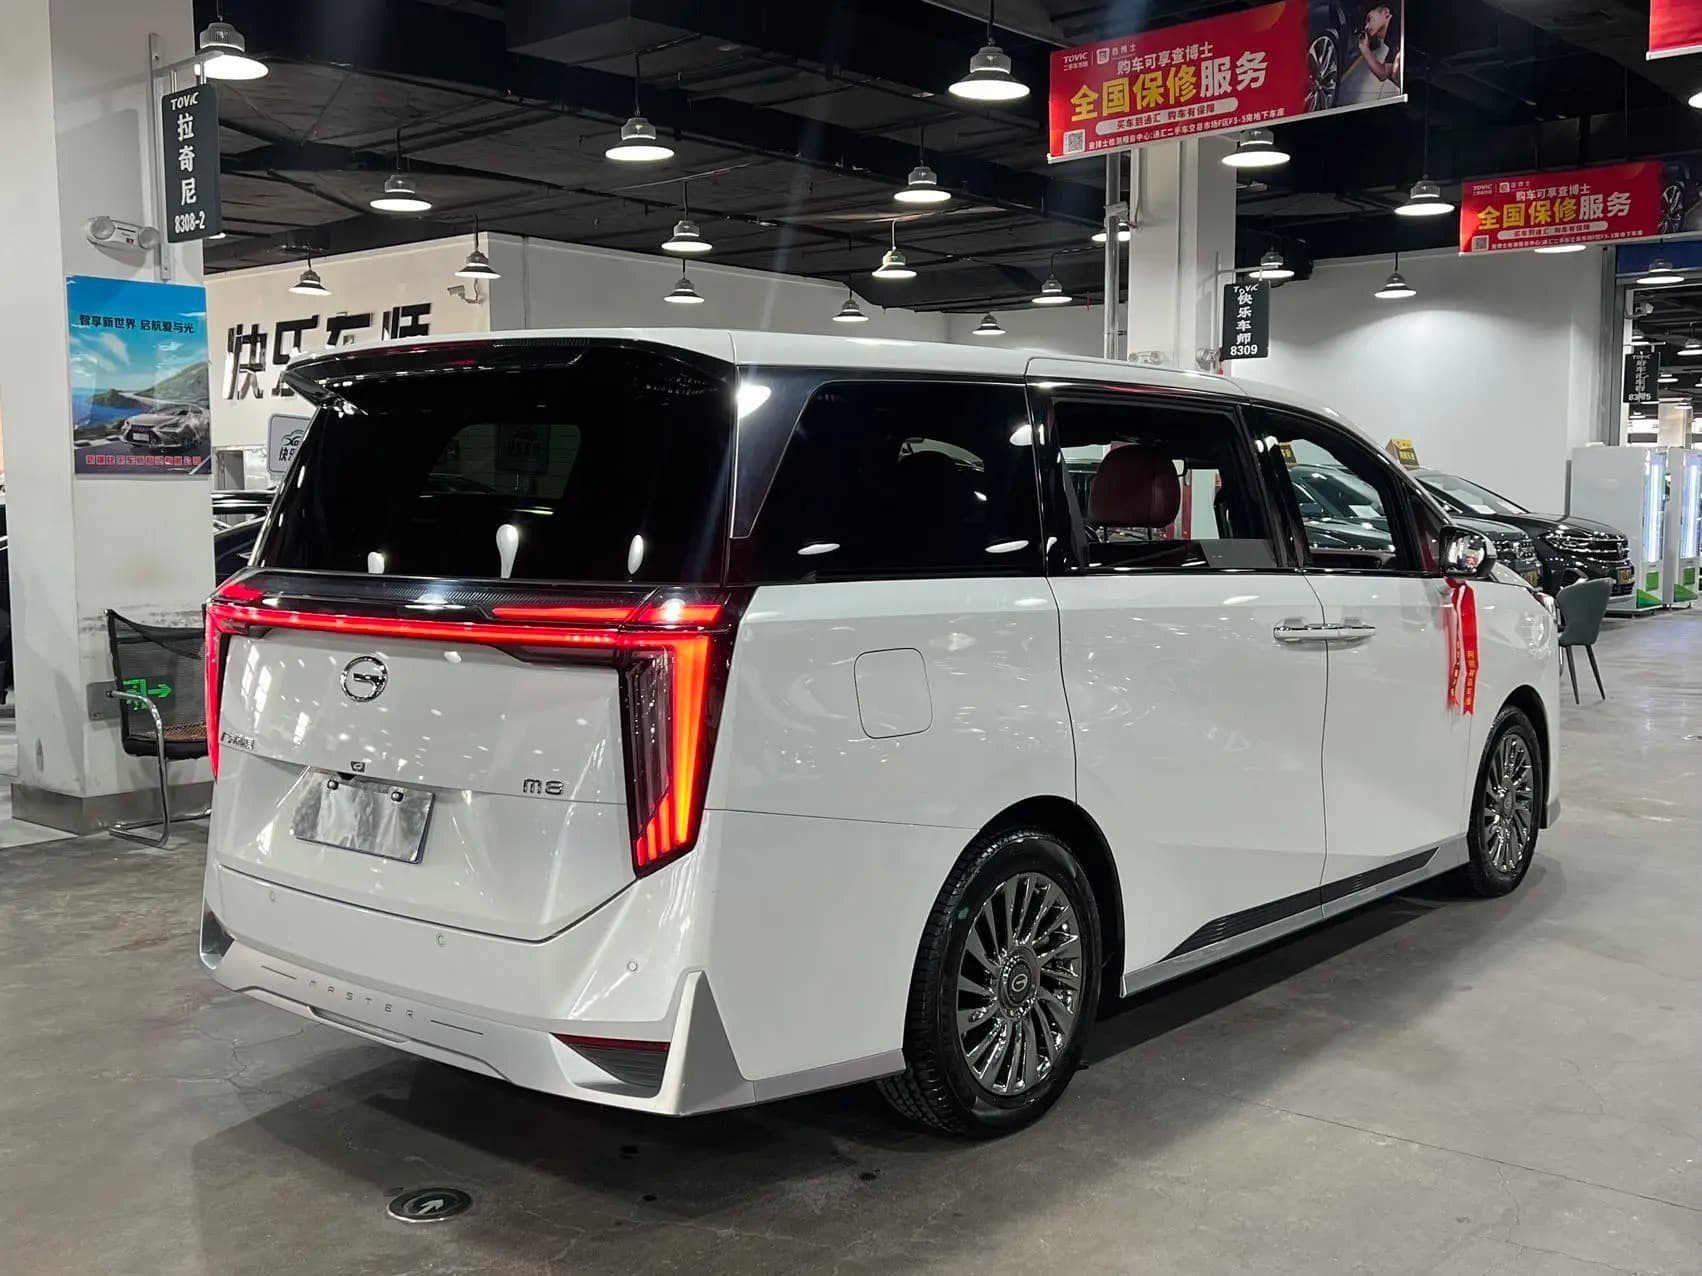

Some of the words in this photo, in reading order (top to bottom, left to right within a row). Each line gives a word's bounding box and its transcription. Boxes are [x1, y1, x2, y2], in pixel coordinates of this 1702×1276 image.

[1063, 52, 1088, 64] TOVIC
[1117, 42, 1214, 75] 购车可享查博士
[1070, 51, 1268, 121] 全国保修服务
[170, 92, 199, 111] TOVIC
[177, 113, 197, 206] 拉奇尼
[1515, 183, 1591, 201] 购车可享查博士
[1477, 191, 1632, 230] 全国保修服务
[174, 211, 205, 233] 8308-2
[1233, 284, 1259, 294] TOVIC
[79, 315, 137, 330] 智享新世界
[140, 319, 195, 334] 启航爱与光
[1236, 292, 1253, 345] 快乐车师
[1230, 344, 1258, 356] 8309
[522, 779, 564, 795] M8
